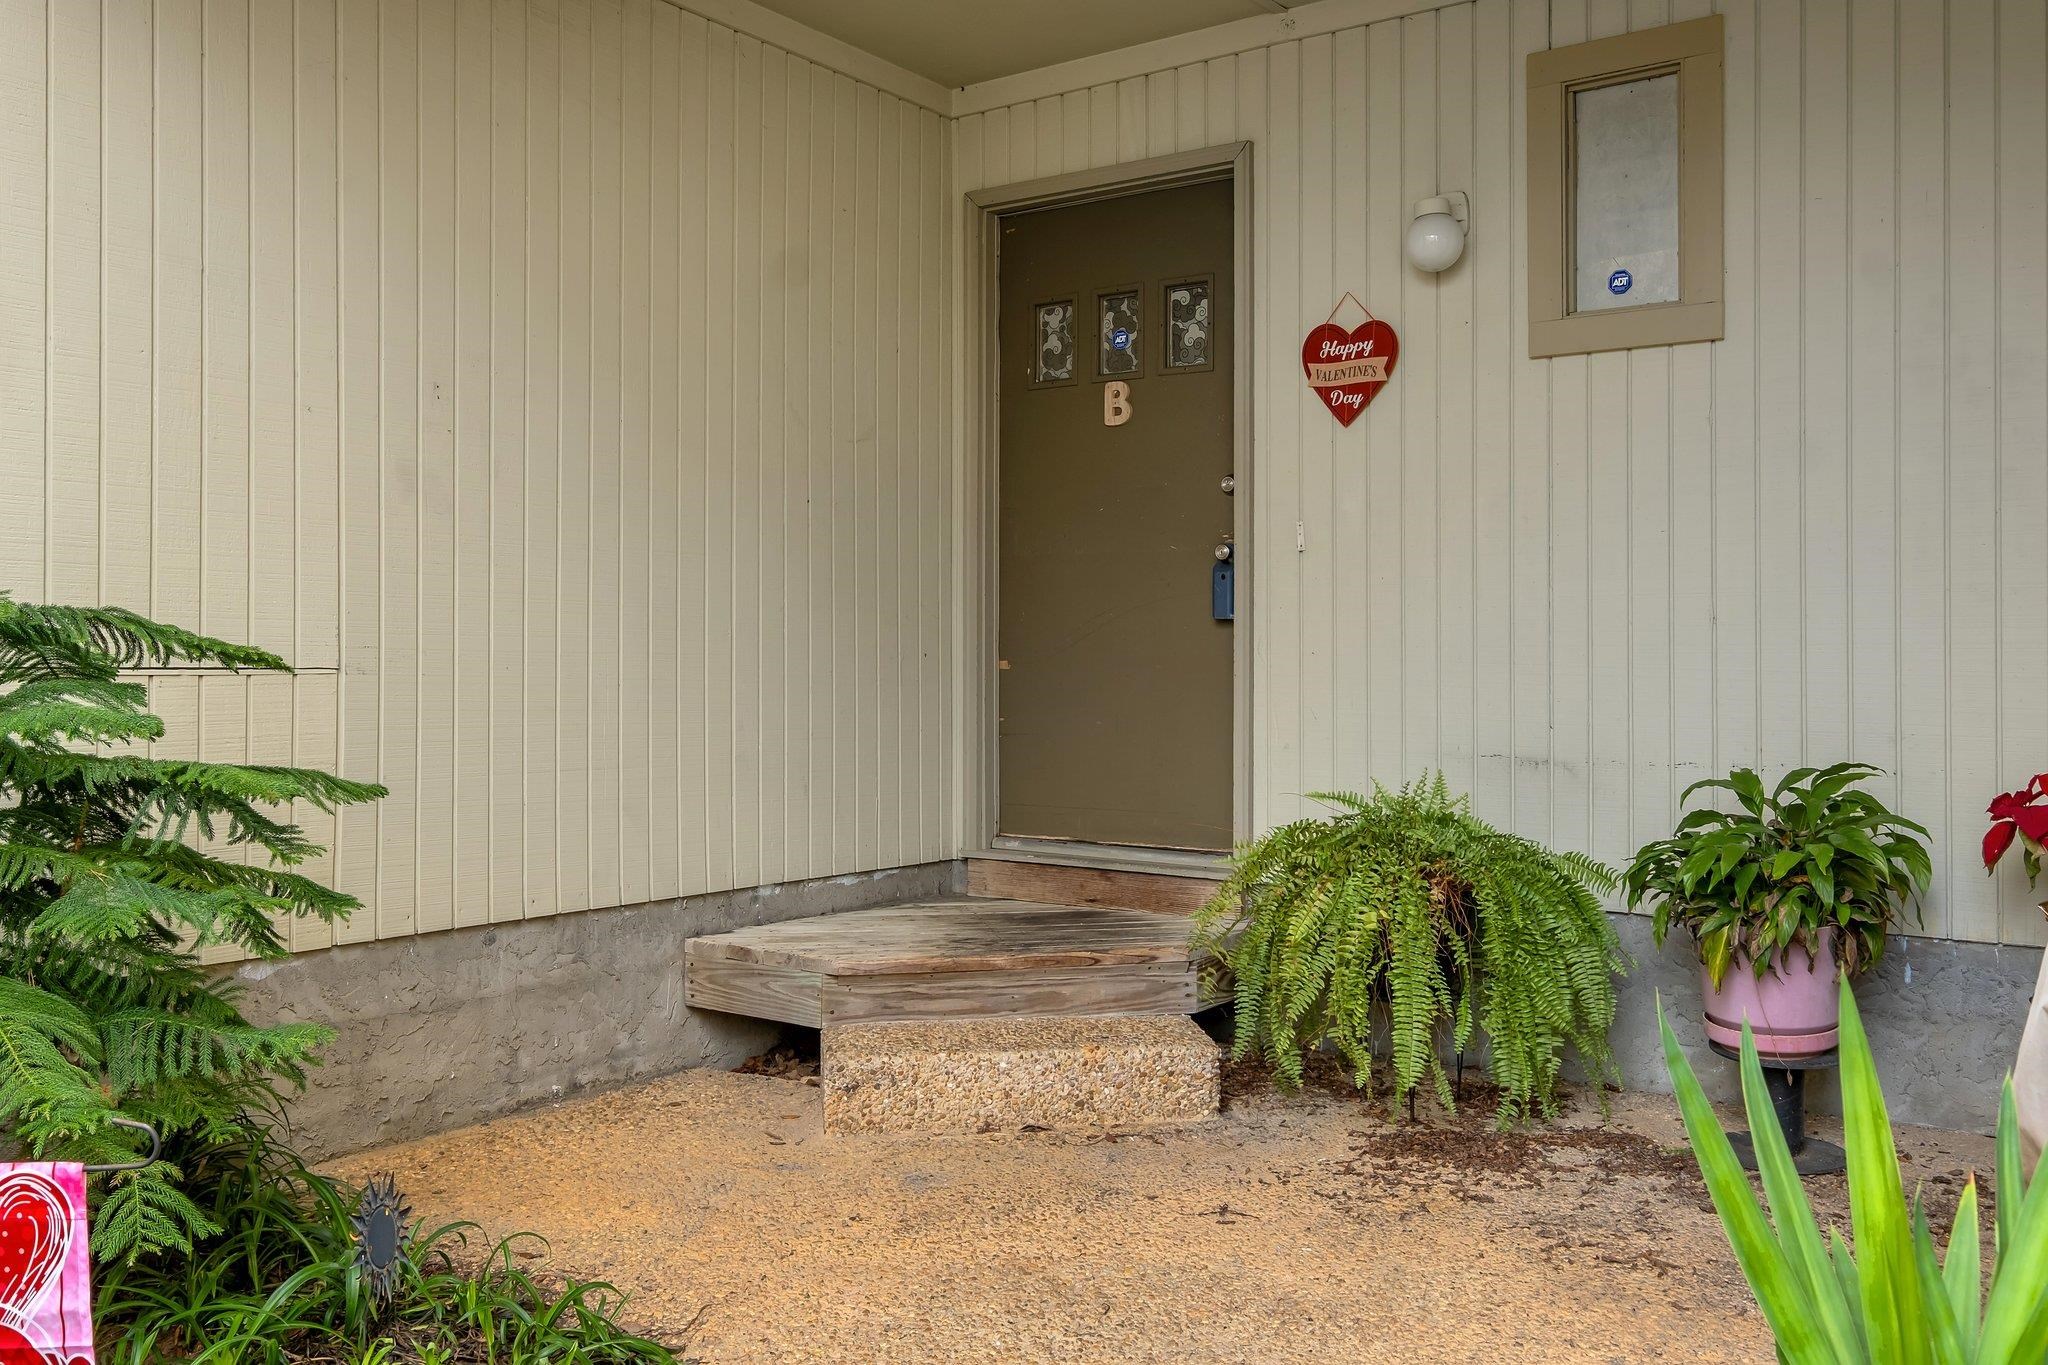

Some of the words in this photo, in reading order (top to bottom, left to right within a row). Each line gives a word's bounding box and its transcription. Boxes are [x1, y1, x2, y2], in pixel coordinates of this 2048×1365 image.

[1612, 277, 1629, 287] ADT
[1114, 335, 1127, 344] ADT
[1320, 340, 1374, 360] Happy
[1315, 365, 1378, 382] VALENTINE'S
[1104, 381, 1131, 426] B
[1330, 389, 1364, 409] Day
